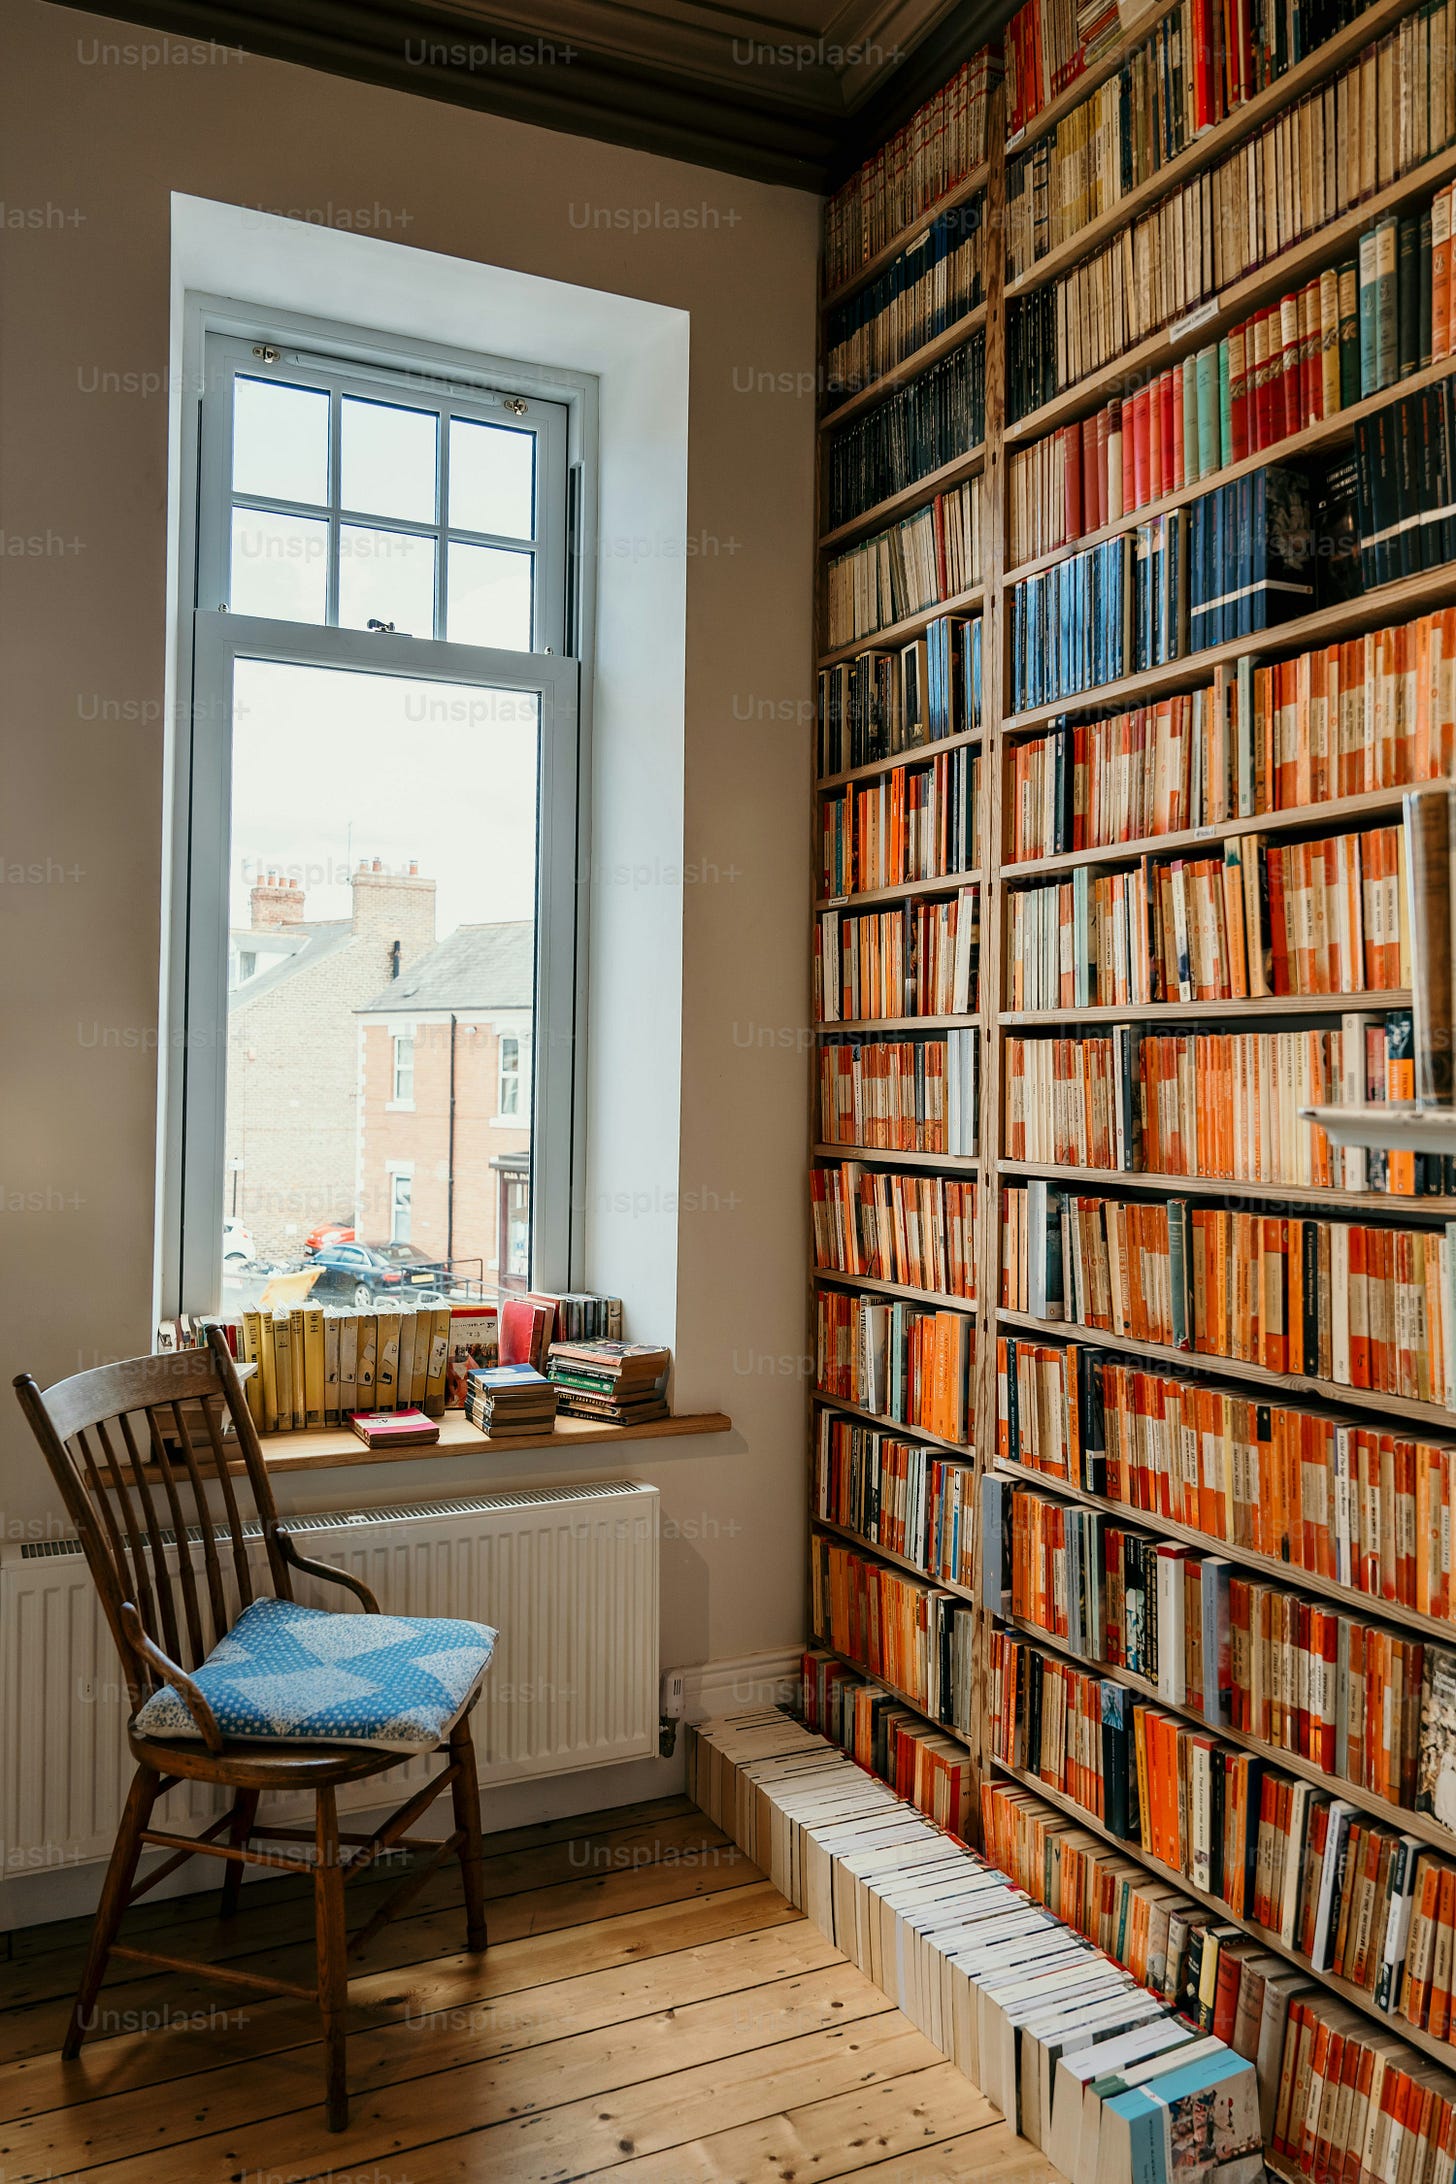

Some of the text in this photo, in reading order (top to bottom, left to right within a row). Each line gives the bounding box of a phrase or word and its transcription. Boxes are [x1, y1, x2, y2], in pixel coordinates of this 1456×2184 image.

[1121, 1272, 1129, 1312] HANDICAP
[1199, 1805, 1204, 1813] OF
[1410, 1941, 1416, 1949] TO
[1407, 1953, 1415, 1973] GONE
